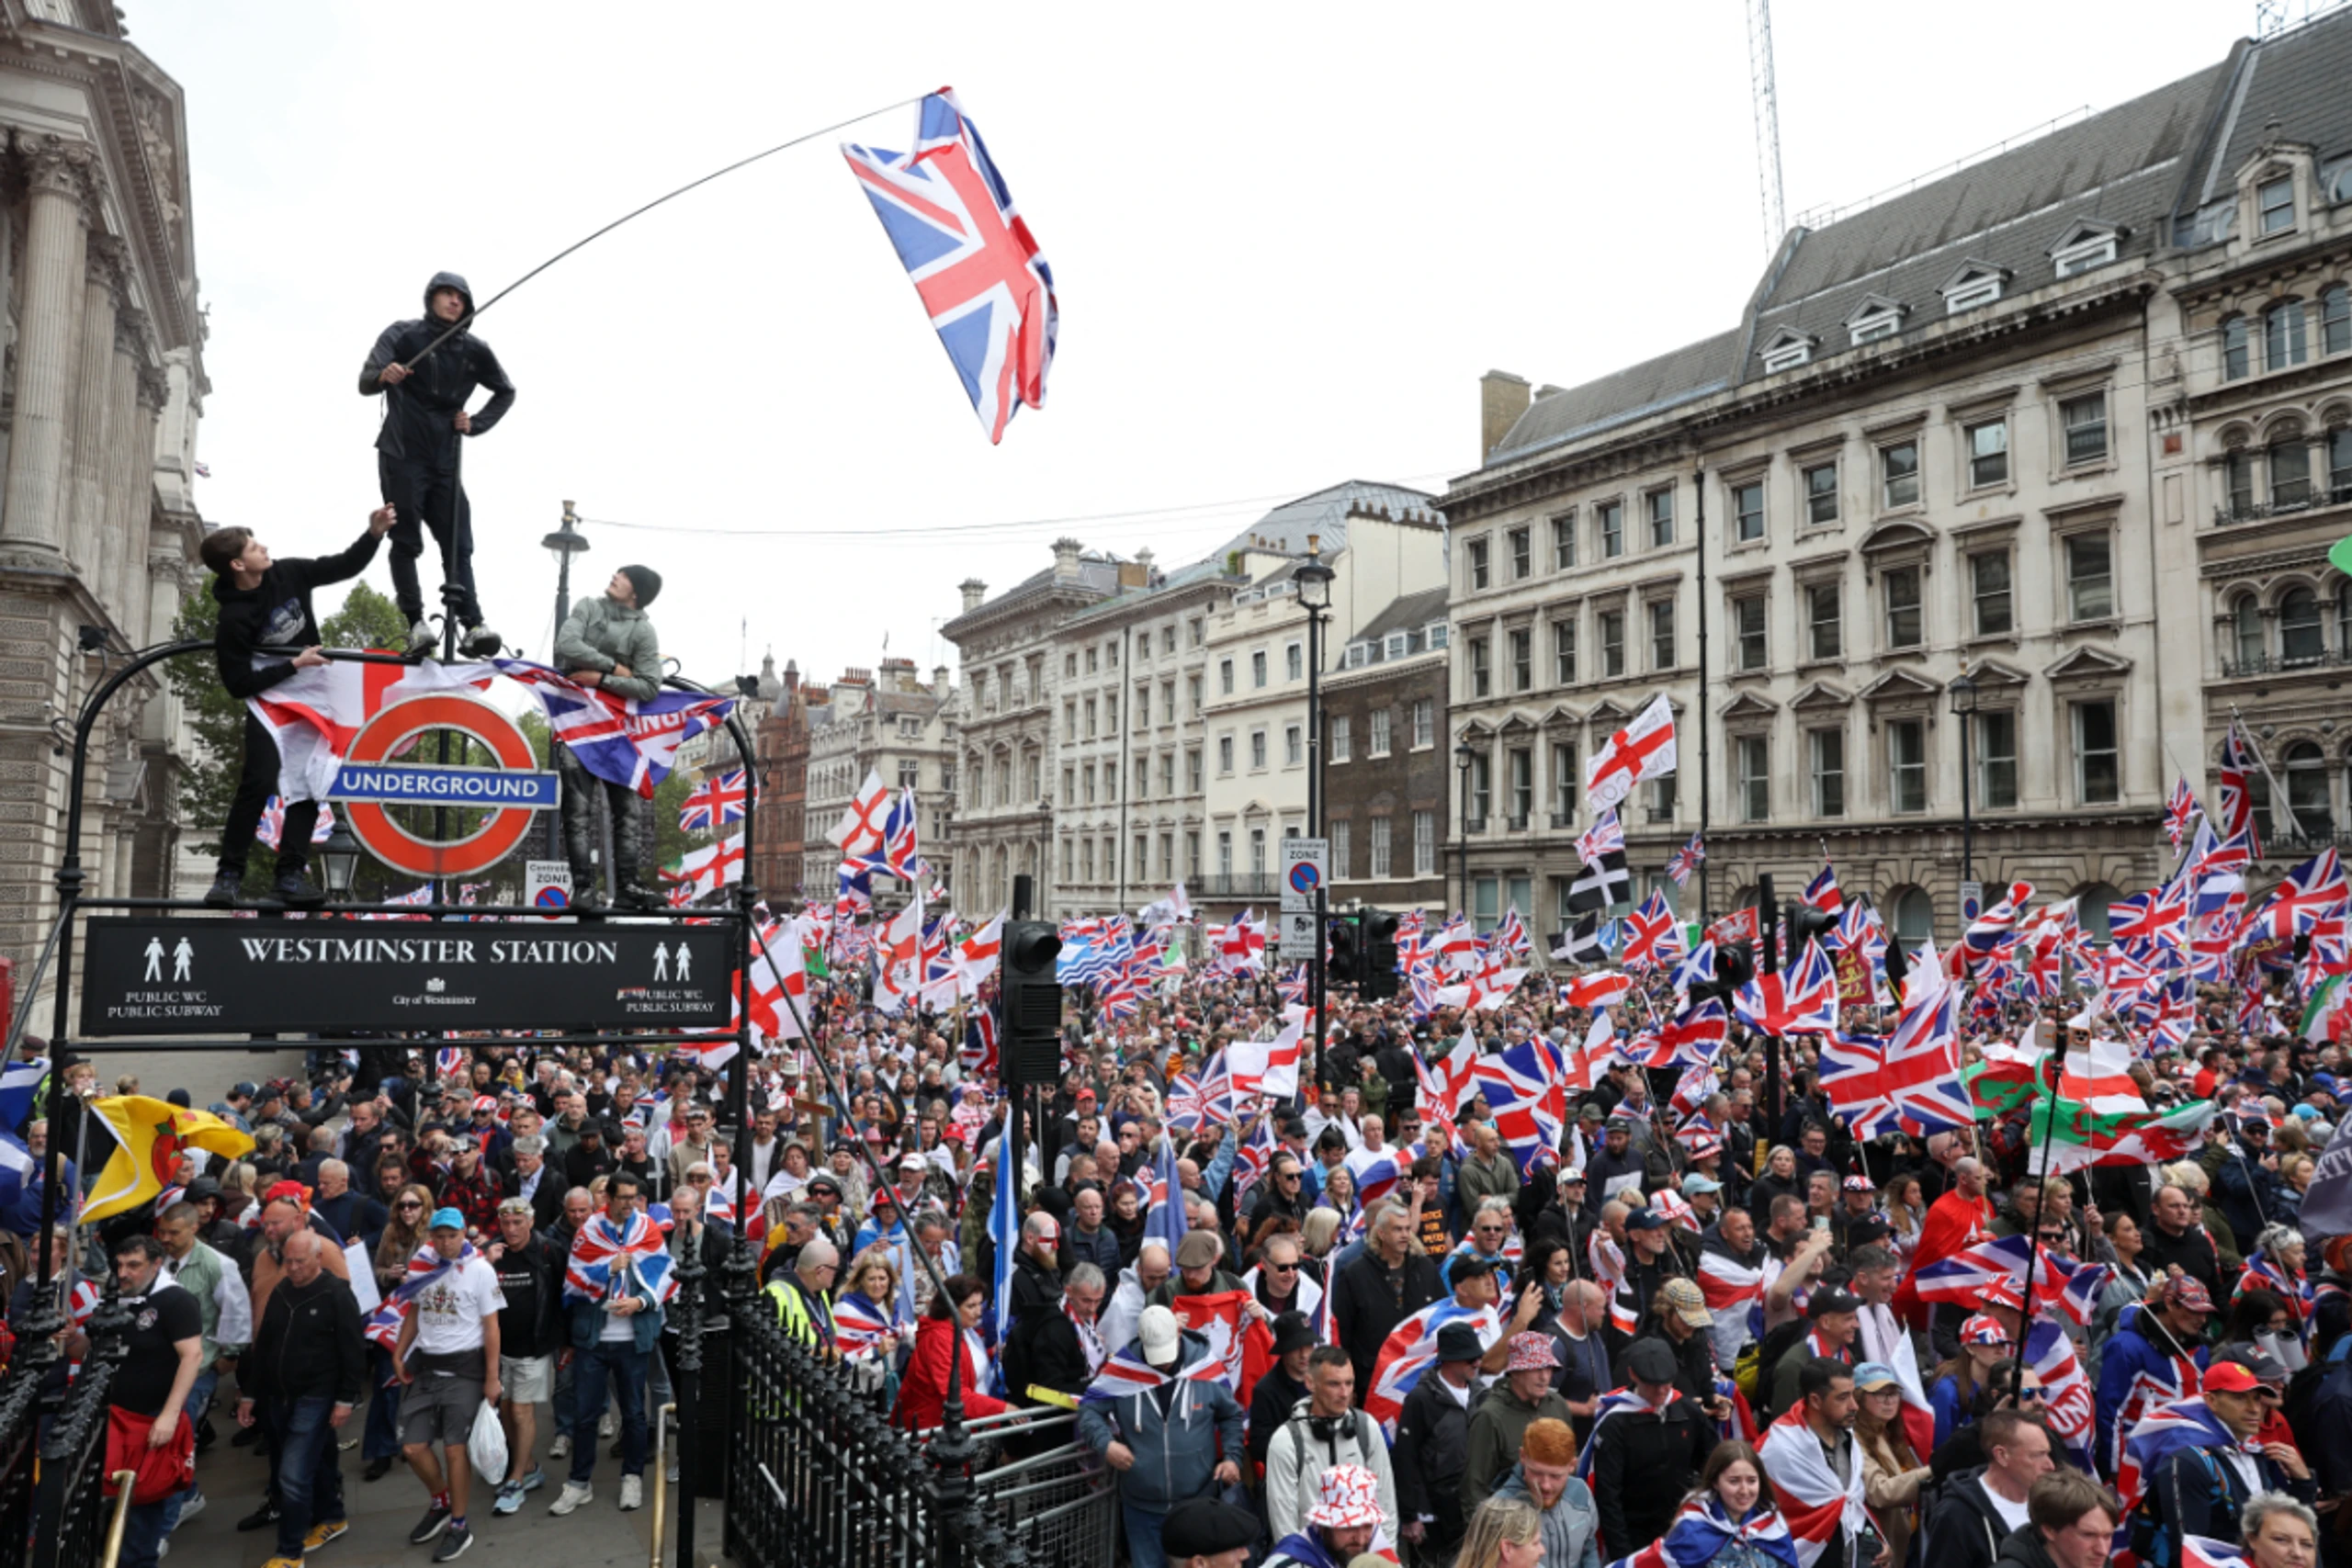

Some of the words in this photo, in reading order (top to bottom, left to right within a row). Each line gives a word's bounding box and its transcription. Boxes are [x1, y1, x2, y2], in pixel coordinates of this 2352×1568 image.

[343, 772, 539, 798] UNDERGROUND
[1290, 851, 1319, 860] ZONE
[529, 864, 570, 874] Controll
[537, 874, 569, 883] ZONE
[240, 937, 477, 964] WESTMINSTER
[490, 940, 619, 964] STATION
[125, 990, 179, 1003] PUBLIC
[182, 989, 208, 1002] WC
[392, 995, 411, 1007] City
[412, 994, 423, 1005] of
[424, 995, 477, 1005] Westminster
[684, 989, 703, 1000] WC
[107, 1006, 163, 1018] PUBLIC
[164, 1005, 222, 1017] SUBWAY
[627, 1002, 668, 1012] PUBLIC
[670, 1002, 715, 1012] SUBWAY
